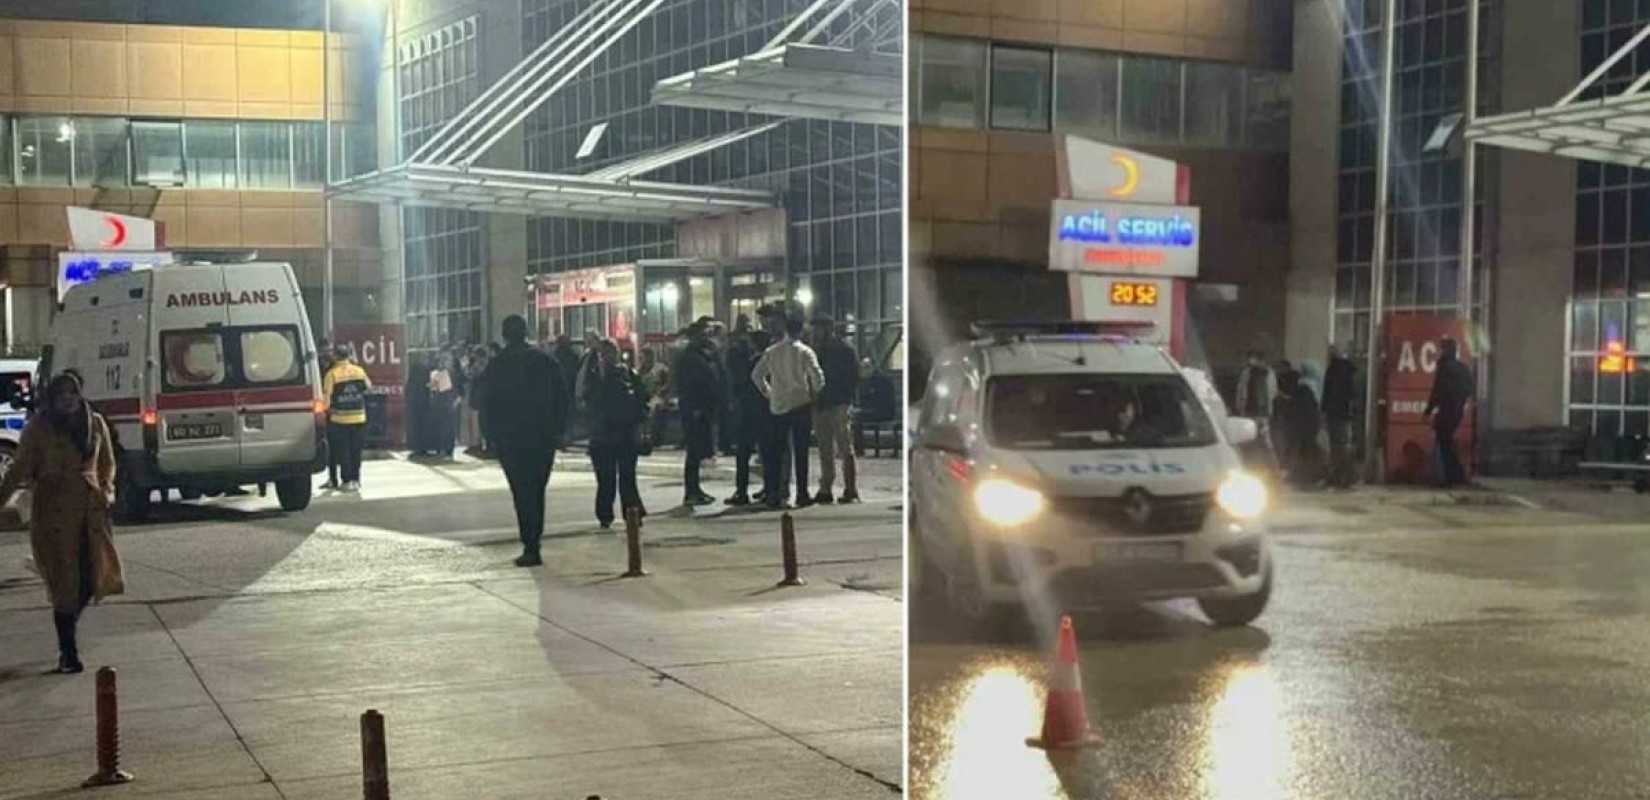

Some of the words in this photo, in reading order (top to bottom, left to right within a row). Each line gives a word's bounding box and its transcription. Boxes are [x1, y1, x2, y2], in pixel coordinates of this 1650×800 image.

[166, 289, 279, 308] AMBULANS
[1113, 284, 1134, 303] 20
[1397, 341, 1438, 373] AC
